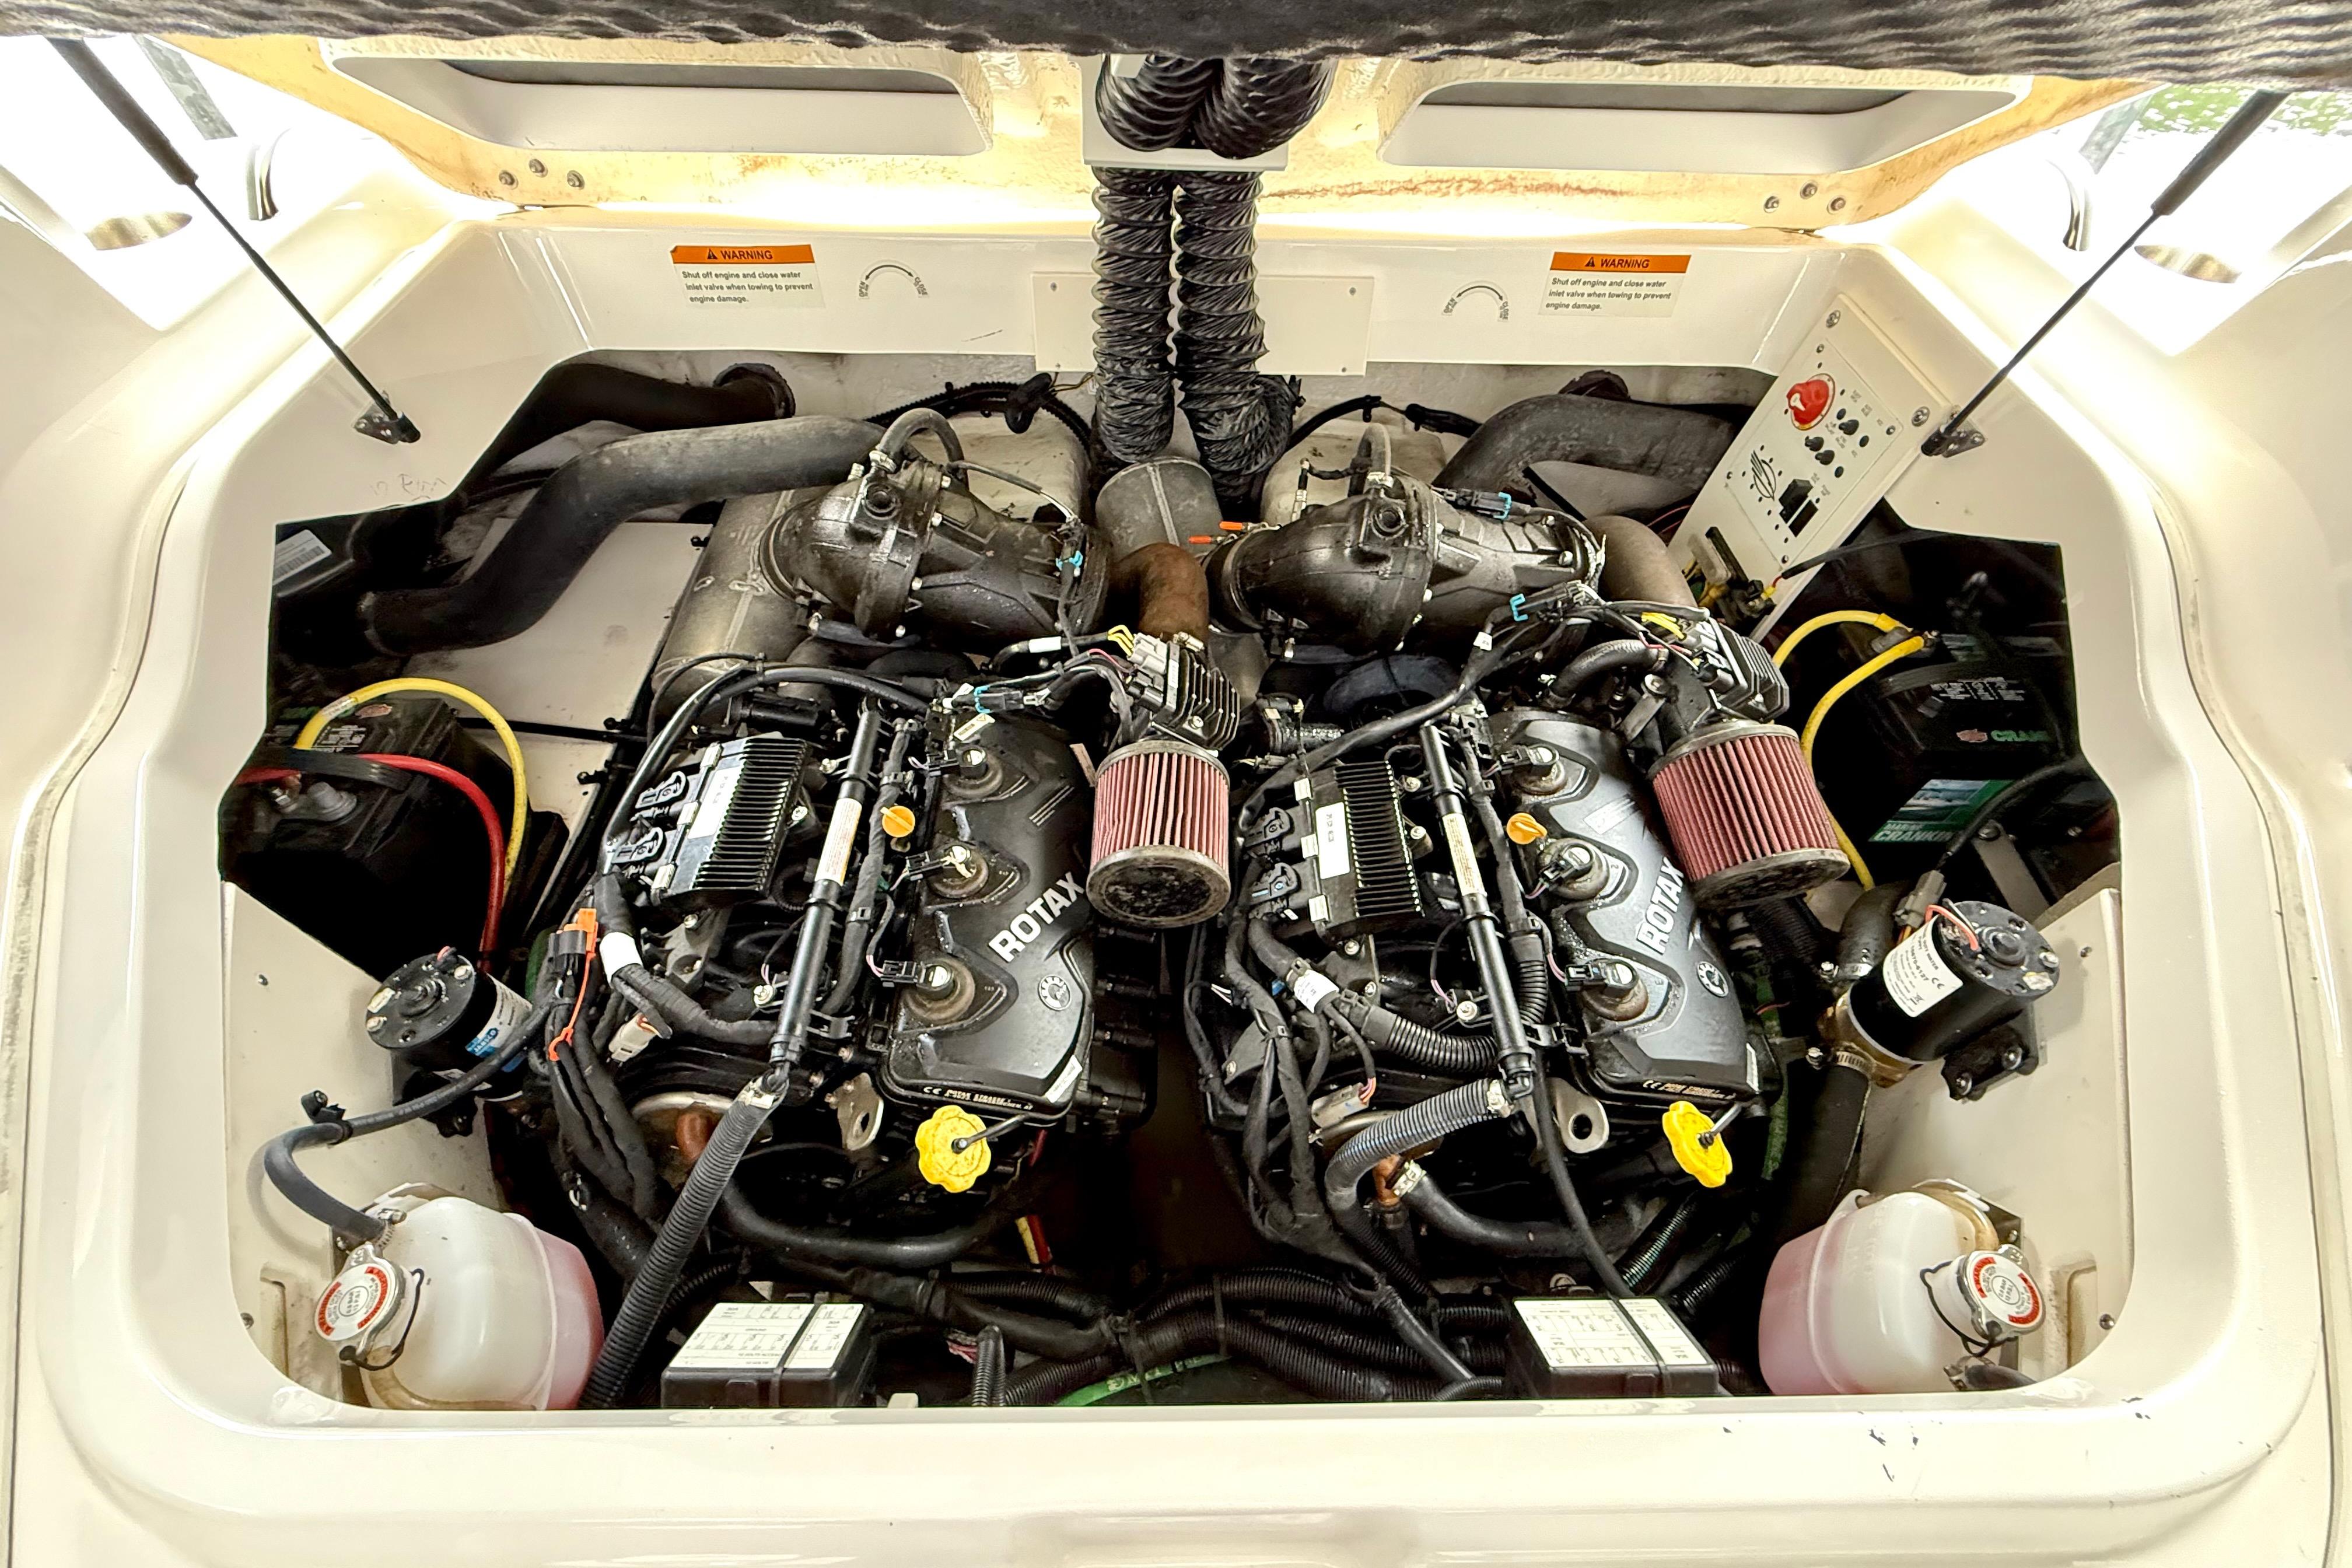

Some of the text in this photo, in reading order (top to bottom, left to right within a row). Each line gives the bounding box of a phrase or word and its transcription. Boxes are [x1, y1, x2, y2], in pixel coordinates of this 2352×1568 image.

[720, 250, 773, 260] WARNING
[1600, 258, 1650, 268] WARNING
[715, 272, 740, 280] engine
[1552, 277, 1569, 285] Shut
[1583, 279, 1606, 288] engine
[748, 284, 774, 292] towing
[690, 295, 749, 303] engine damage.
[1608, 292, 1632, 300] towing
[1546, 302, 1602, 311] engine damage.
[1636, 856, 1685, 956] ROTAX
[988, 871, 1085, 963] ROTAX
